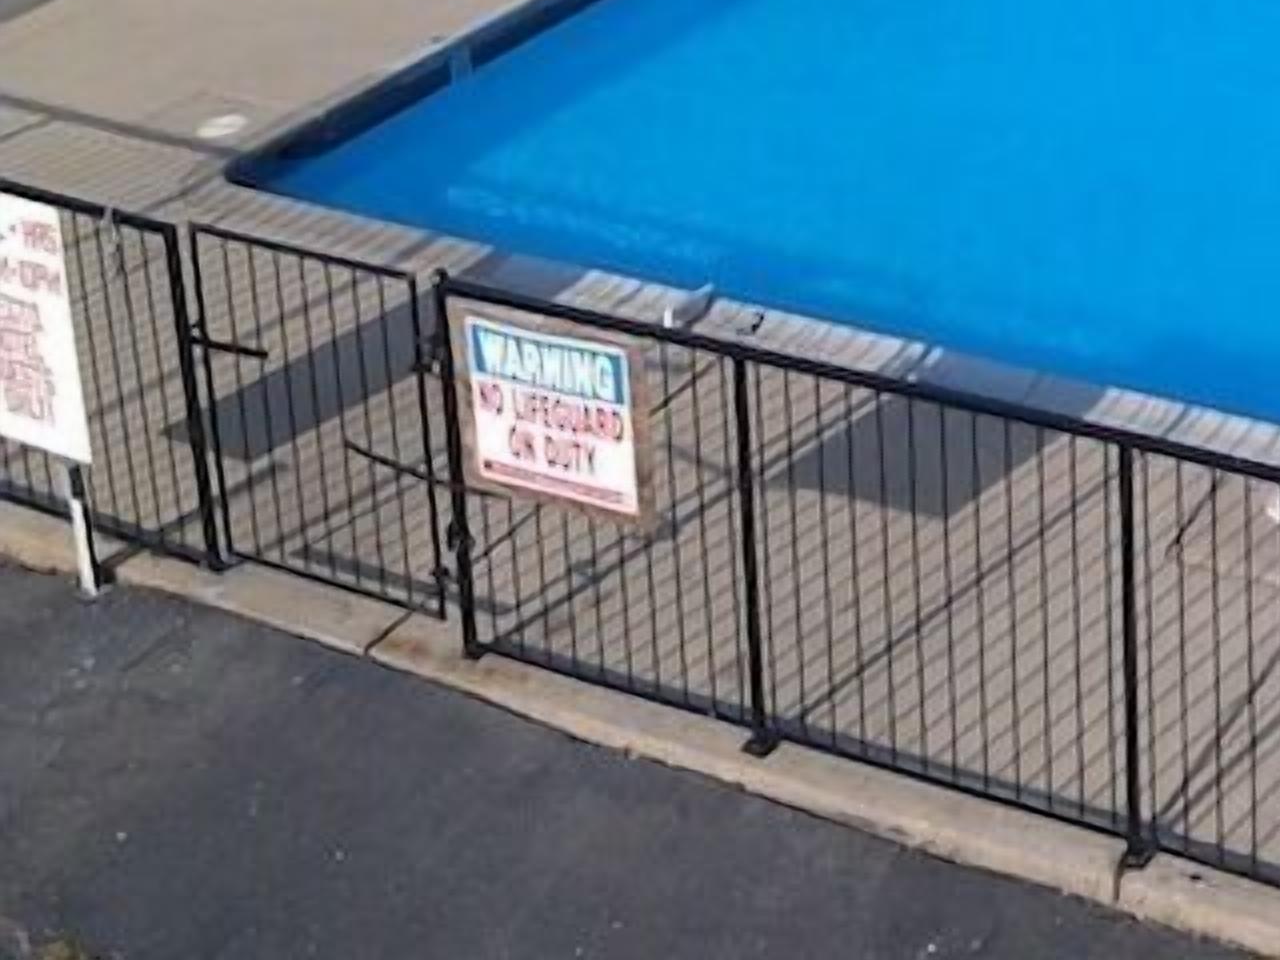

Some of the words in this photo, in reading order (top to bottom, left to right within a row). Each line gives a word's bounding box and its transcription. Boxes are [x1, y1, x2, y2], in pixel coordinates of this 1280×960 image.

[477, 329, 615, 401] WARNING
[479, 382, 504, 416] NO
[513, 389, 624, 442] LIFEGUARD
[510, 425, 536, 461] ON
[545, 435, 596, 476] DUTY
